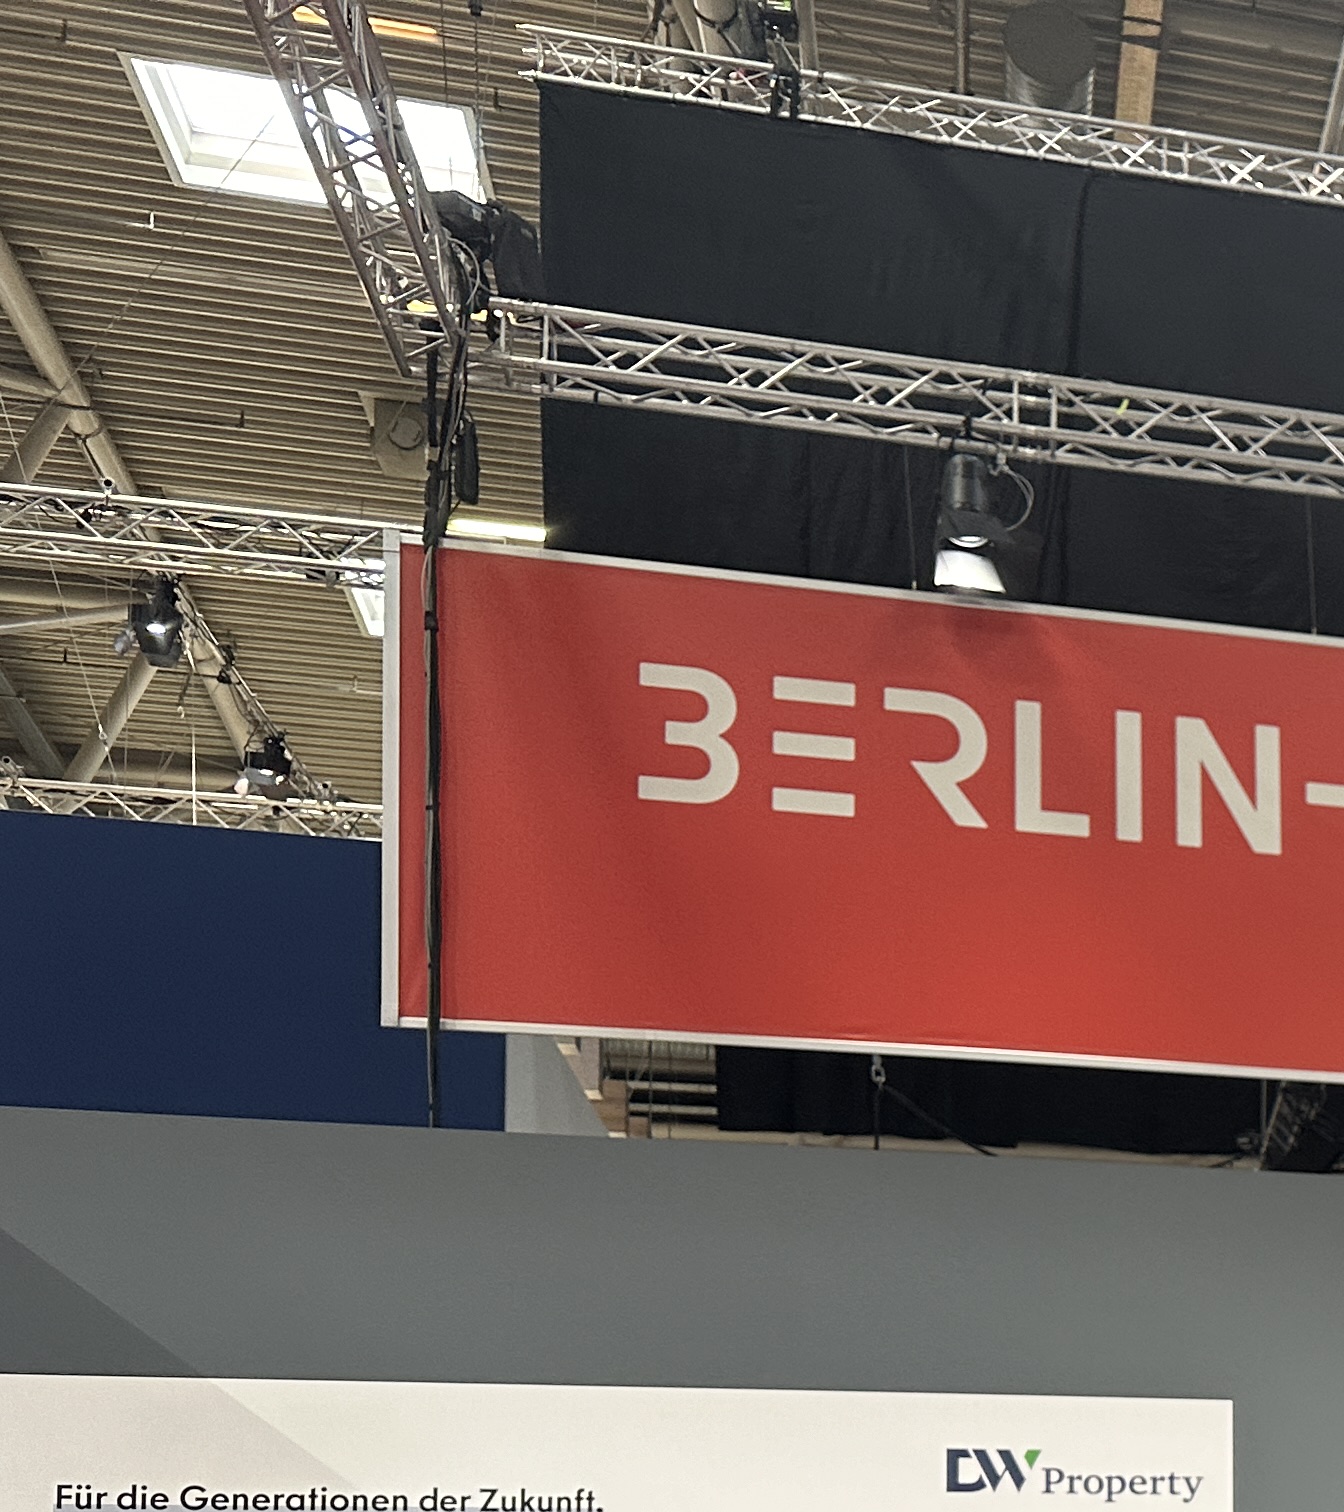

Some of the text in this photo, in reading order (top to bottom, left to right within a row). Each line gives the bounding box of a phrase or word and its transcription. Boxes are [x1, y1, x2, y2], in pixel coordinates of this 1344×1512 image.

[55, 1485, 108, 1511] Für
[116, 1485, 169, 1511] die
[179, 1485, 409, 1512] Generationen
[418, 1487, 469, 1512] der
[1042, 1467, 1204, 1503] Property
